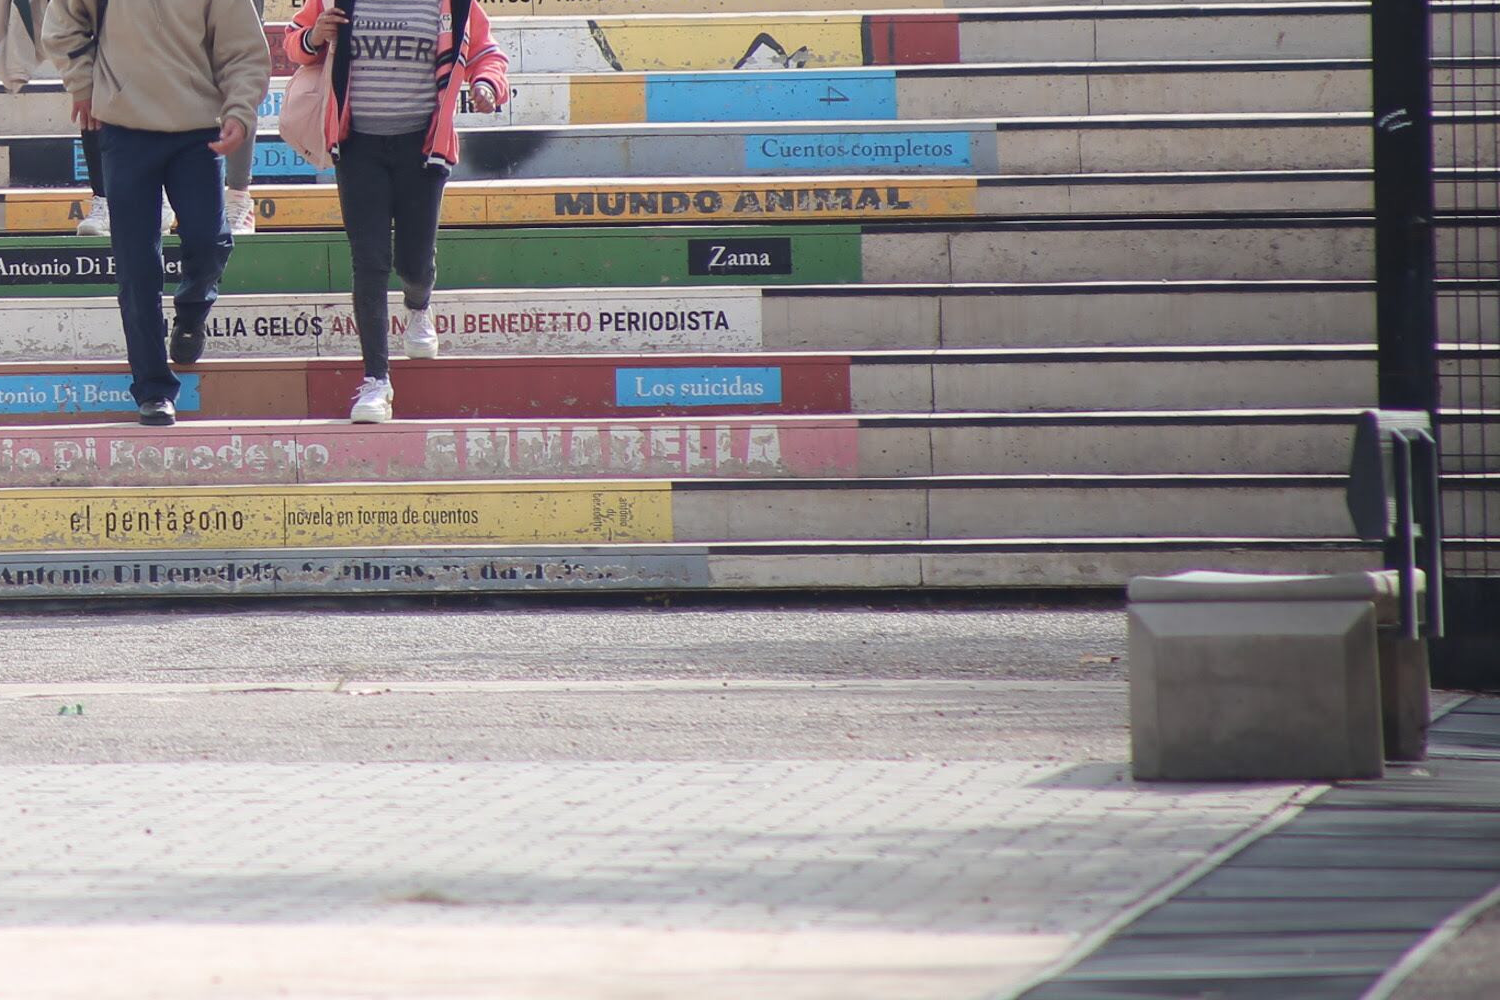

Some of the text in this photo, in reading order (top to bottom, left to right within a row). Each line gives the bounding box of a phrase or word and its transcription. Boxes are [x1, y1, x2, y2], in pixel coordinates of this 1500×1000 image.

[761, 138, 953, 163] Cuentos completos
[554, 186, 910, 216] MUNDO ANIMAL
[77, 256, 101, 275] Di
[708, 246, 771, 268] Zama
[253, 311, 323, 337] GELÓS
[435, 314, 456, 334] DI
[465, 312, 592, 334] BENEDETTO
[599, 310, 730, 332] PERIODISTA
[53, 384, 77, 403] Di
[635, 374, 764, 397] Los suicidas
[54, 437, 97, 473] Di
[69, 504, 479, 538] el pentágono novela en forma de cuentos
[0, 563, 109, 588] Antonio
[113, 563, 141, 584] Di
